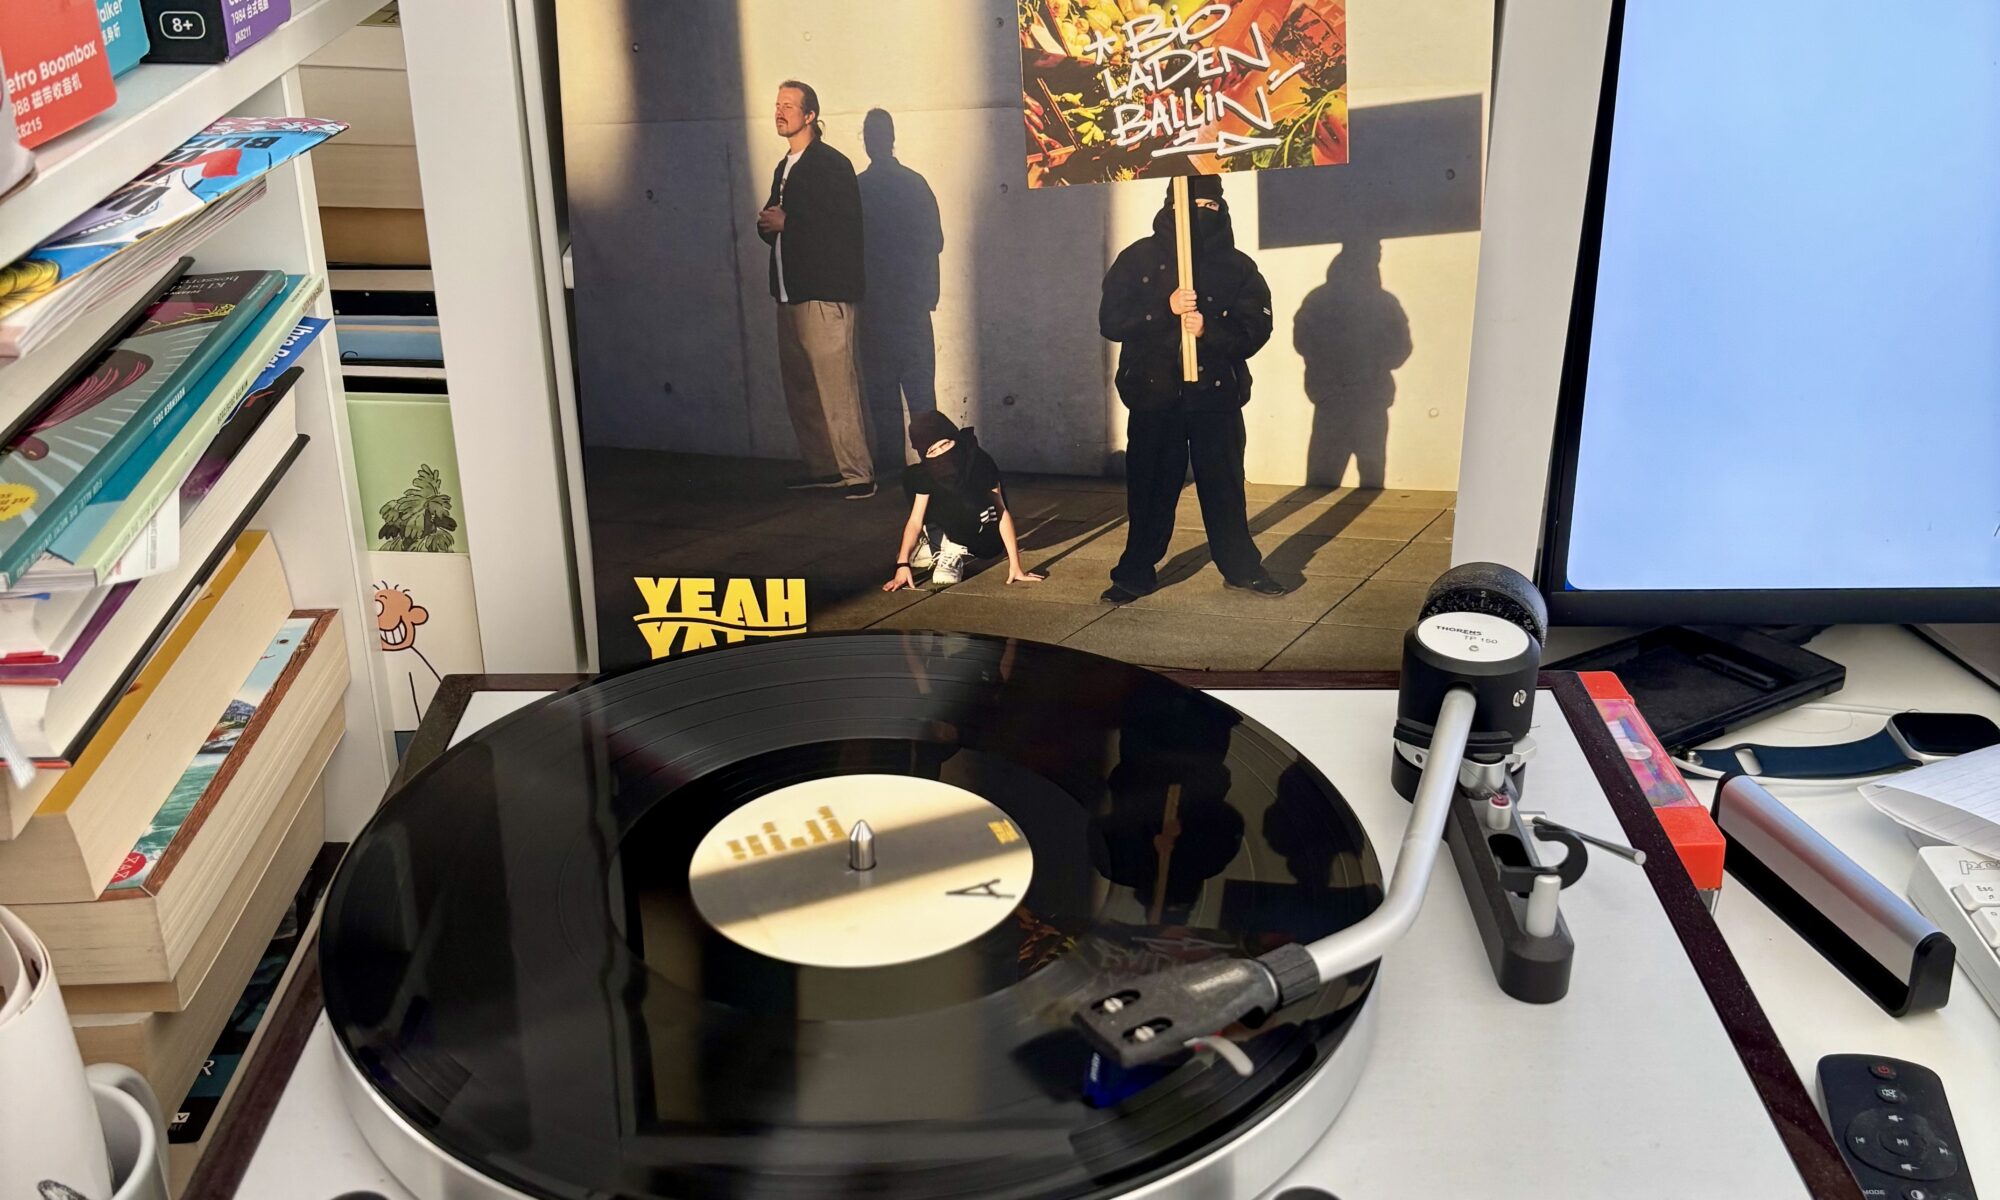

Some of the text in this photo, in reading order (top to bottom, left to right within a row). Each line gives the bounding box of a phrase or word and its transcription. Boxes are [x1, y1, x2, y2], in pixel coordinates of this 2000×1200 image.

[98, 0, 123, 23] alker
[231, 7, 247, 26] 1984
[172, 18, 194, 33] 8+
[6, 39, 98, 94] etro Boombox
[1101, 22, 1271, 100] LADEN
[152, 386, 186, 429] NOVEMBER 2025
[633, 577, 807, 627] YEAH
[1436, 625, 1482, 636] THORENS
[1481, 637, 1498, 645] 150
[945, 878, 1016, 900] A
